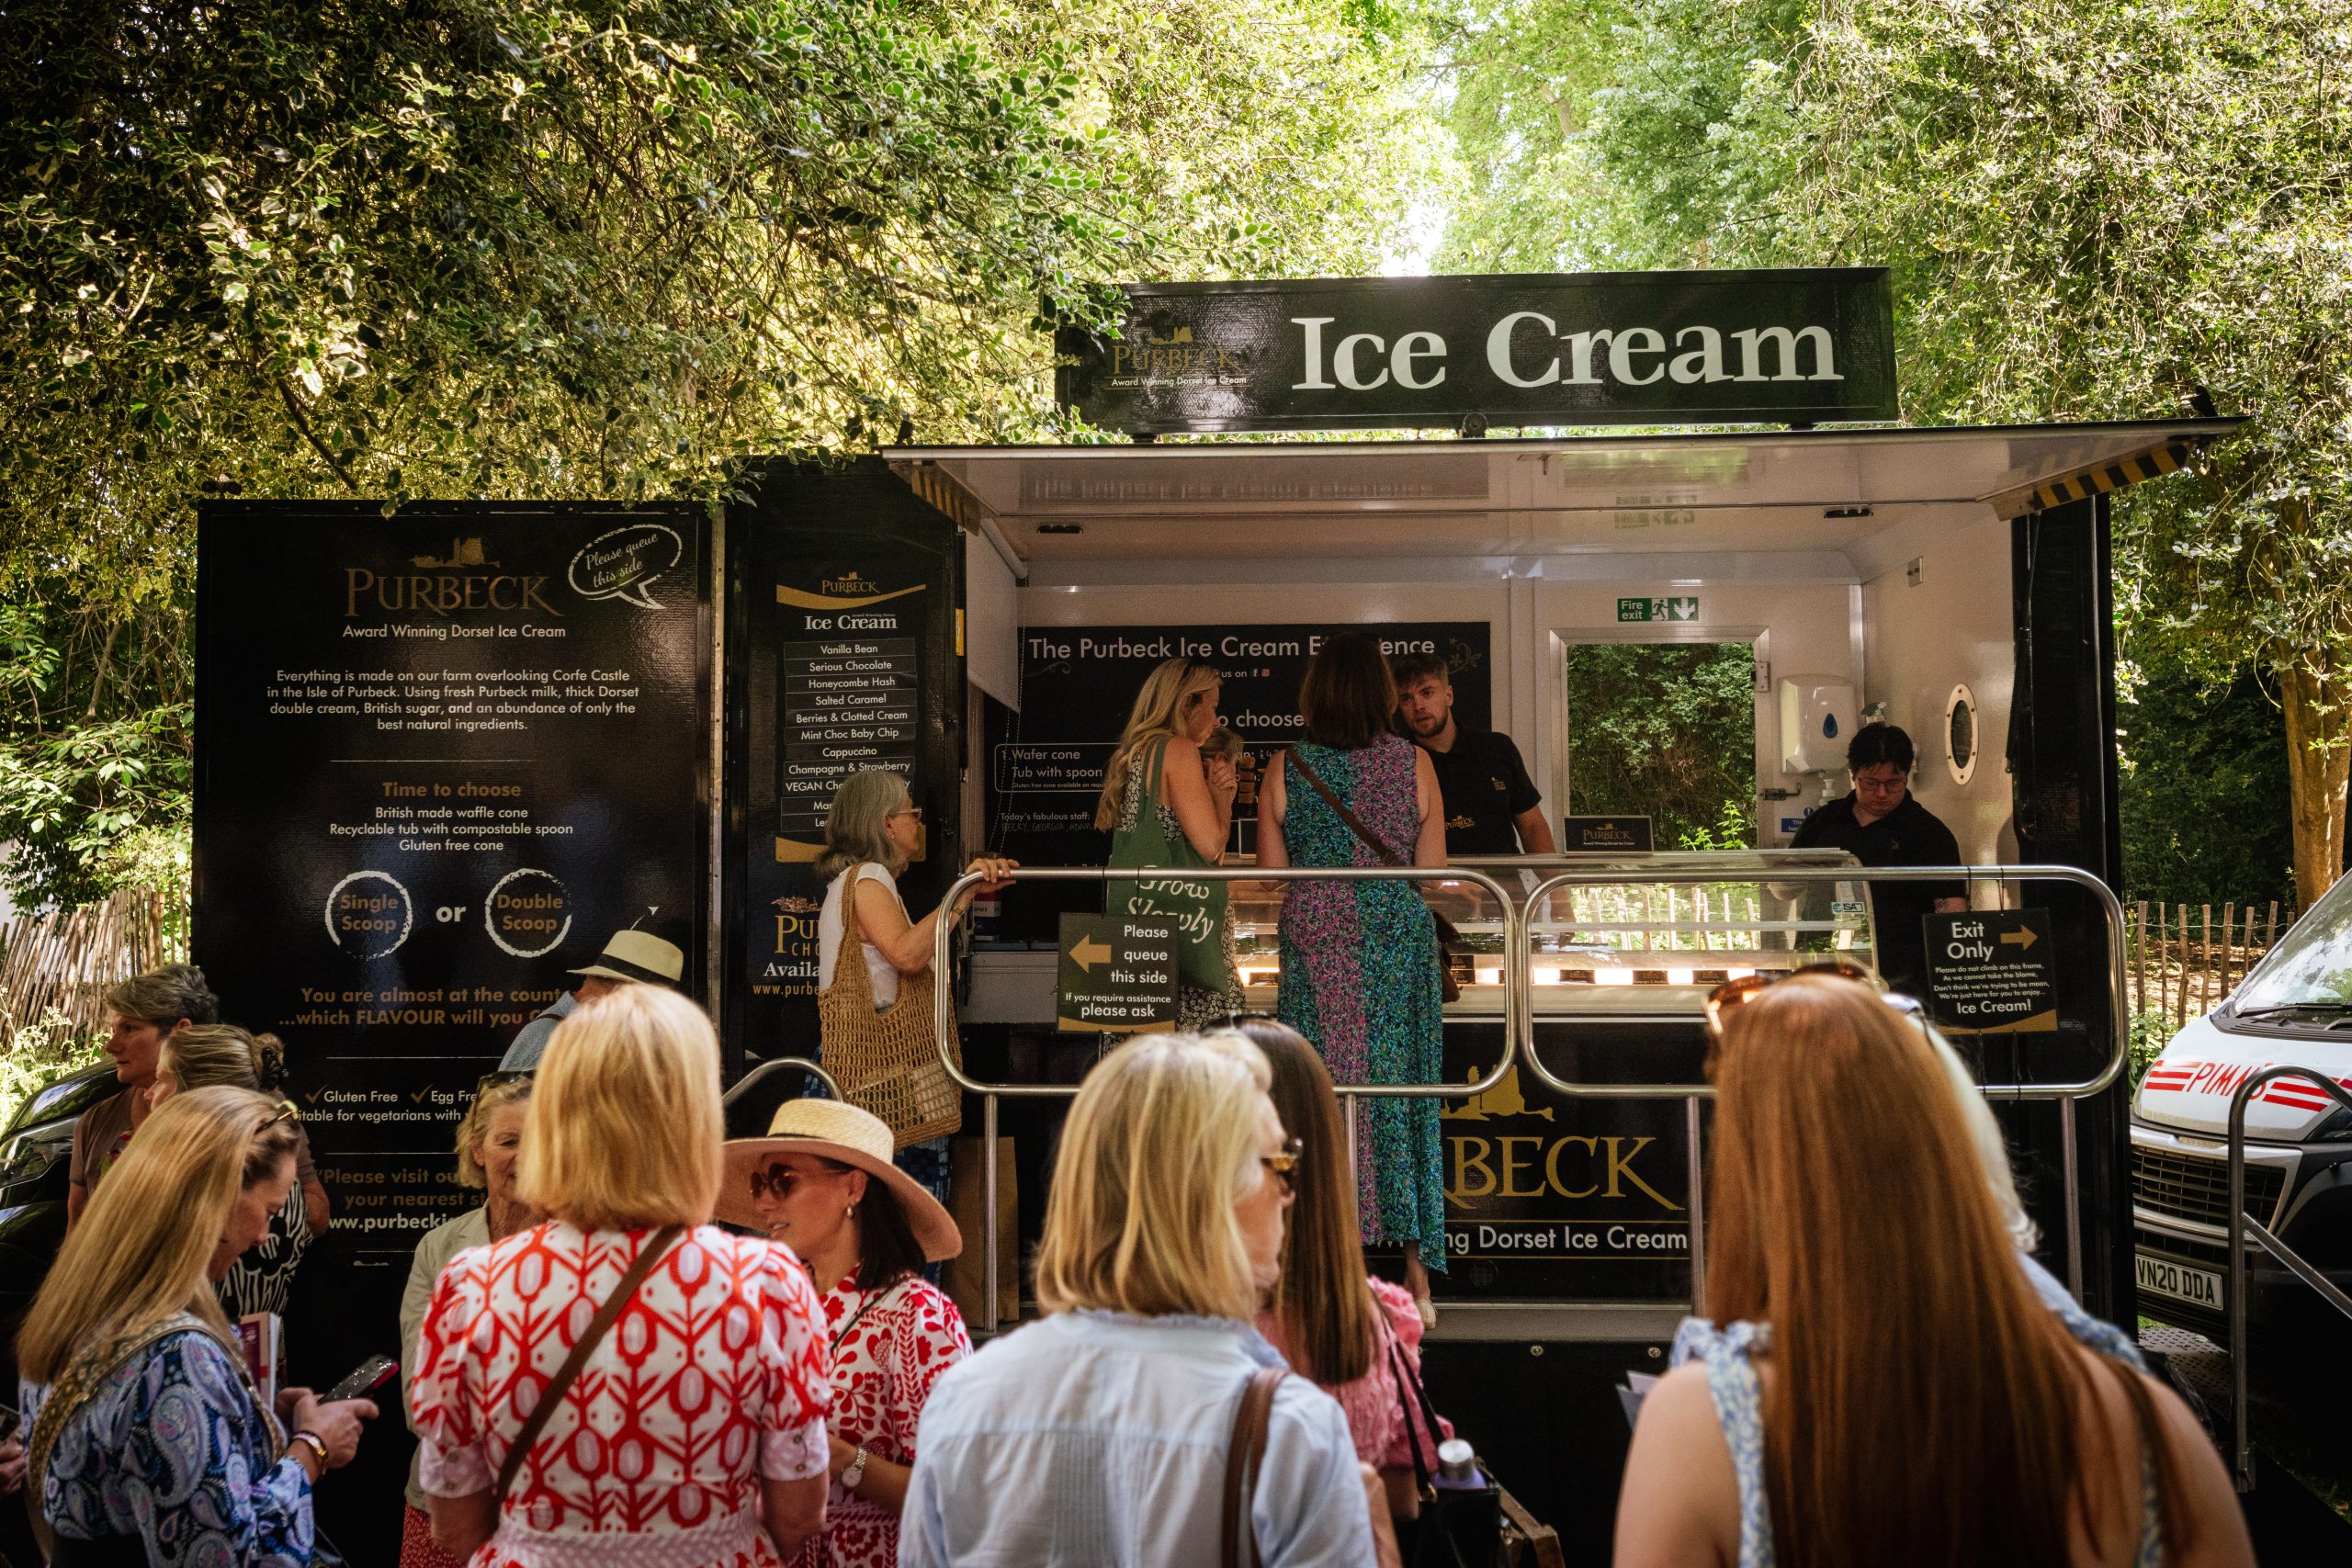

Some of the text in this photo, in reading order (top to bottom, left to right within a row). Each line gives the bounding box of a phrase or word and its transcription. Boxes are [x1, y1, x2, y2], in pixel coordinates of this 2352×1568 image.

[1291, 311, 1844, 389] Ice Cream
[585, 534, 658, 570] Please queue
[594, 557, 643, 588] this side
[344, 568, 565, 616] PURBECK
[821, 581, 879, 594] PURBECK
[1622, 601, 1643, 610] Fire
[1622, 610, 1643, 619] exit
[804, 615, 898, 630] Ice Cream
[343, 625, 566, 640] Award Winning Dorset Ice Cream
[820, 645, 877, 654] Vanilla Bean
[1029, 637, 1299, 659] The Purbeck Ice Cream
[809, 660, 892, 671] Serious Chocolate
[277, 670, 340, 683] Everything
[345, 670, 354, 681] is
[359, 670, 393, 681] made
[442, 670, 471, 681] farm
[476, 670, 548, 683] overlooking
[552, 670, 586, 681] Corfe
[591, 670, 629, 681] Castle
[808, 677, 895, 690] Honeycombe Hash
[267, 686, 639, 699] in the Isle of Purbeck. Using fresh Purbeck milk, thick Dorset
[816, 694, 886, 705] Salted Caramel
[270, 702, 636, 716] double cream, British sugar, and an abundance of only the
[797, 711, 907, 723] Berries & Clotted Cream
[378, 718, 527, 732] best natural ingredients.
[801, 728, 899, 739] Mint Choc Baby Chip
[823, 747, 876, 759] Cappuccino
[1012, 750, 1080, 760] Wafer cone
[789, 761, 910, 775] Champagne & Strawberry
[1012, 766, 1102, 779] Tub with spoon
[382, 782, 522, 797] Time to choose
[786, 782, 822, 791] VEGAN
[376, 807, 528, 818] British made waffle cone
[330, 823, 573, 837] Recyclable tub with compostable spoon
[400, 840, 503, 851] Gluten free cone
[340, 894, 563, 922] Single or Double
[342, 916, 558, 933] Scoop Scoop
[1125, 925, 1168, 938] Please
[1951, 921, 1984, 938] Exit
[1125, 951, 1168, 963] queue
[1947, 942, 1994, 962] Only
[763, 962, 819, 976] Availa
[1111, 970, 1167, 983] this side
[301, 987, 503, 1002] You are almost at the
[1066, 993, 1073, 1001] If
[1093, 993, 1124, 1003] require
[1127, 994, 1170, 1003] assistance
[1081, 1003, 1155, 1019] please ask
[1957, 999, 2031, 1014] Ice Cream!
[279, 1010, 349, 1025] ...which
[356, 1010, 446, 1024] FLAVOUR
[451, 1010, 482, 1024] will
[490, 1013, 523, 1028] you
[324, 1090, 398, 1101] Gluten Free
[432, 1090, 454, 1104] Egg
[337, 1110, 354, 1121] for
[358, 1110, 431, 1123] vegetarians
[435, 1110, 460, 1121] with
[1443, 1136, 1686, 1211] BECK
[1479, 1225, 1555, 1248] Dorset
[1566, 1225, 1598, 1248] Ice
[1607, 1225, 1687, 1249] Cream
[2137, 1258, 2214, 1303] VN20 DDA
